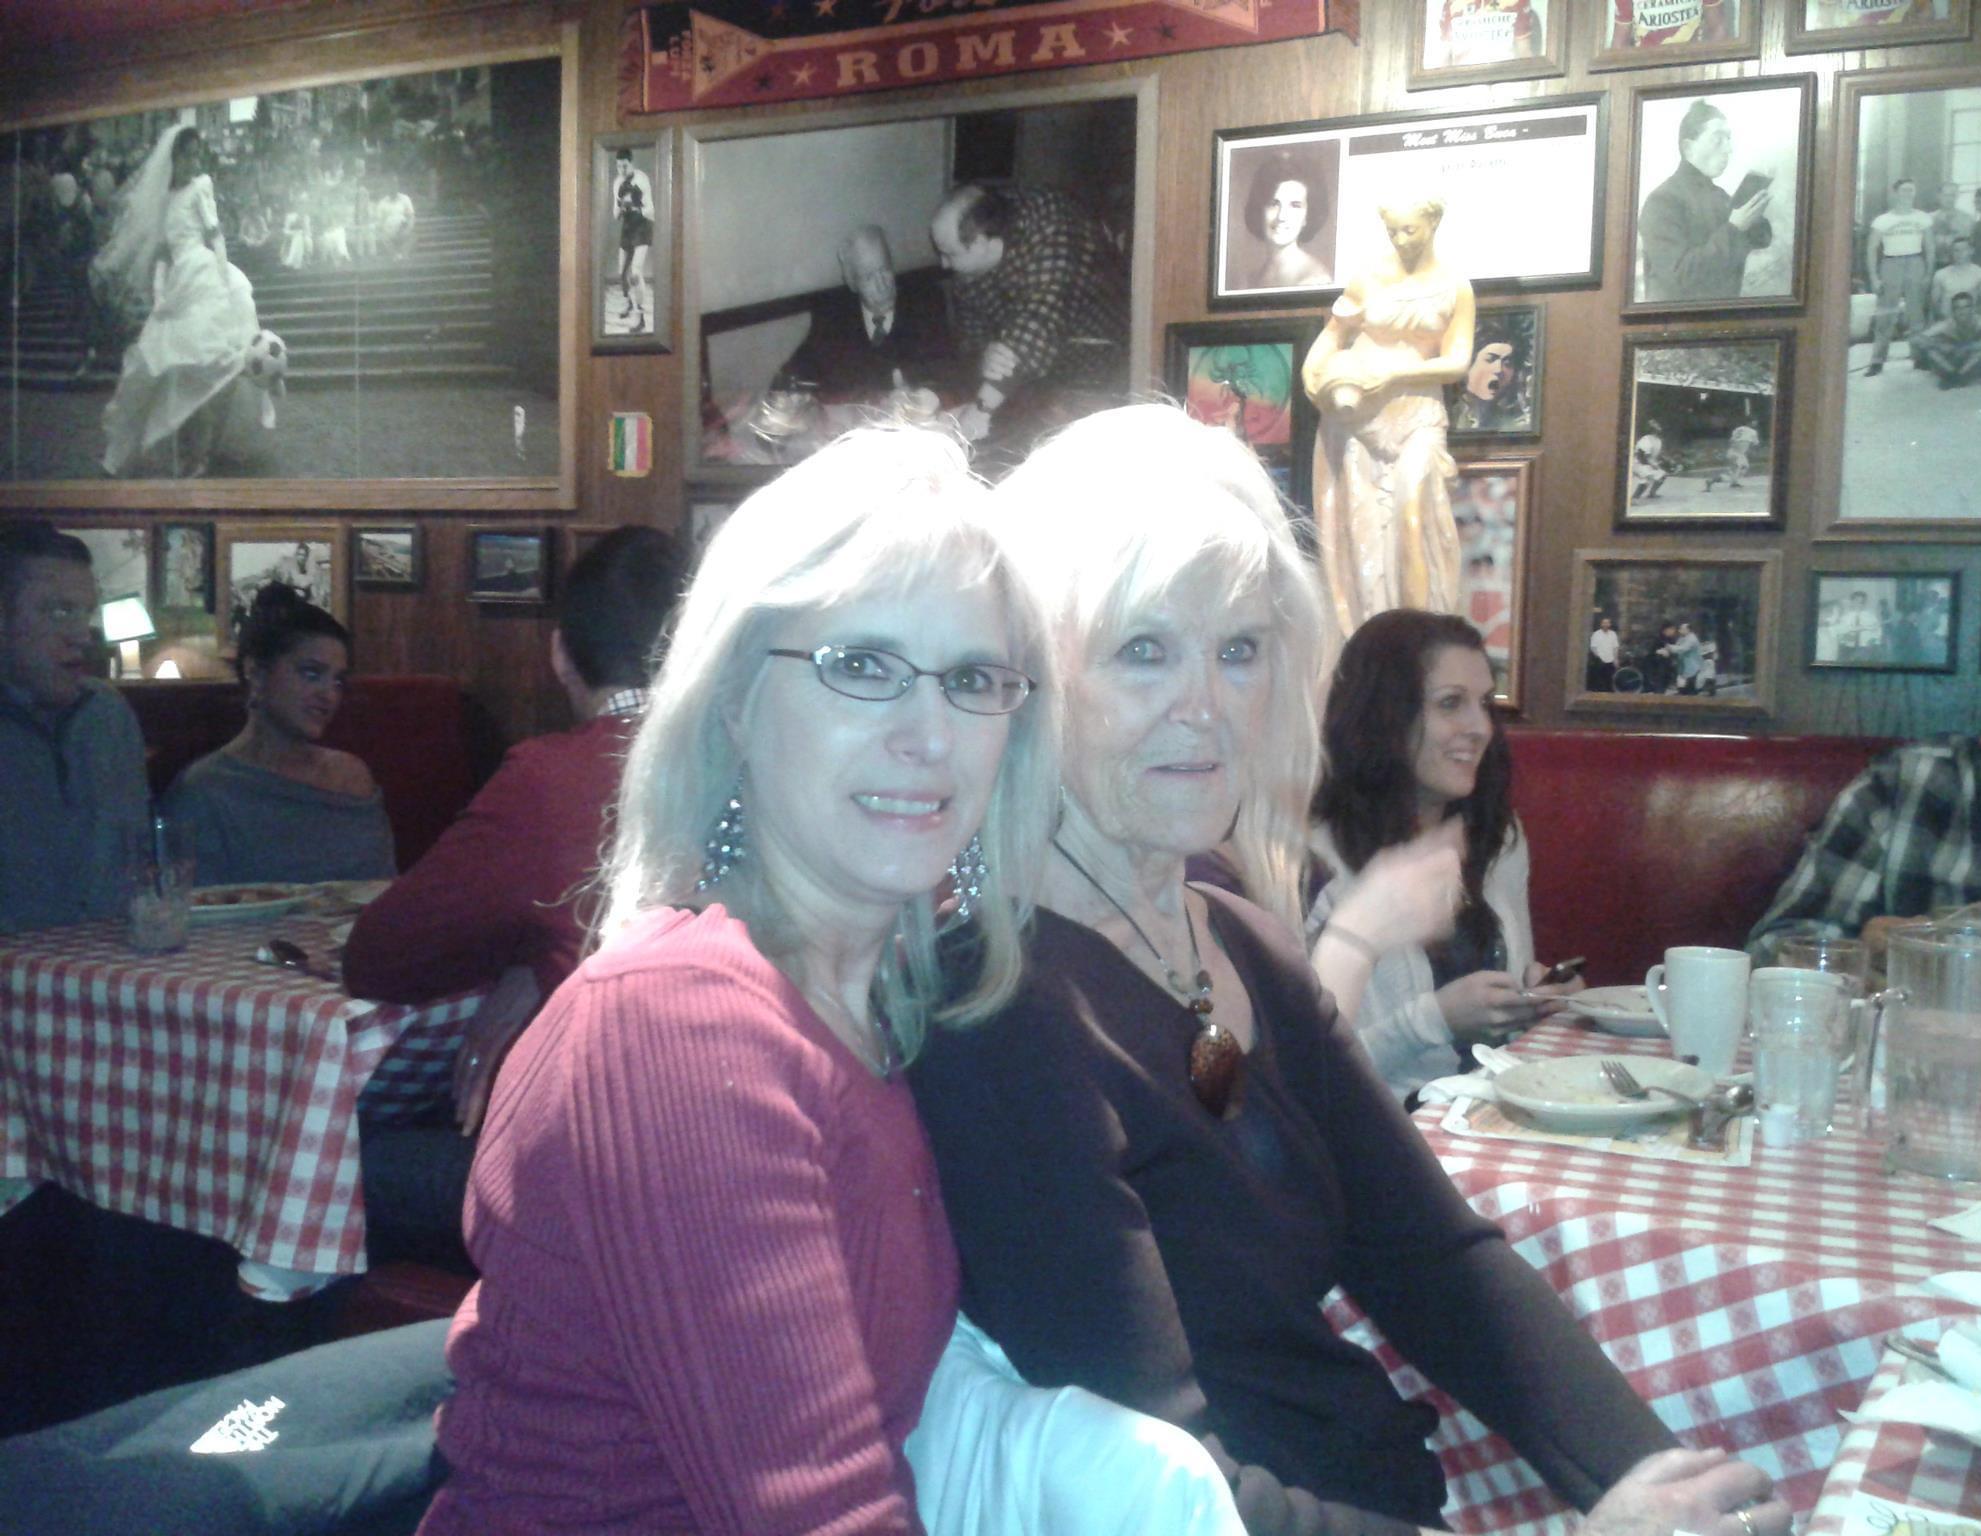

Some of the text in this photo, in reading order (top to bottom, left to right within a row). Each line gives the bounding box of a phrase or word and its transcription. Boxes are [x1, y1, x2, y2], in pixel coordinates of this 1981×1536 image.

[1639, 7, 1698, 26] ARIOSTEA
[836, 22, 1086, 88] ROMA
[1442, 128, 1478, 144] Miss
